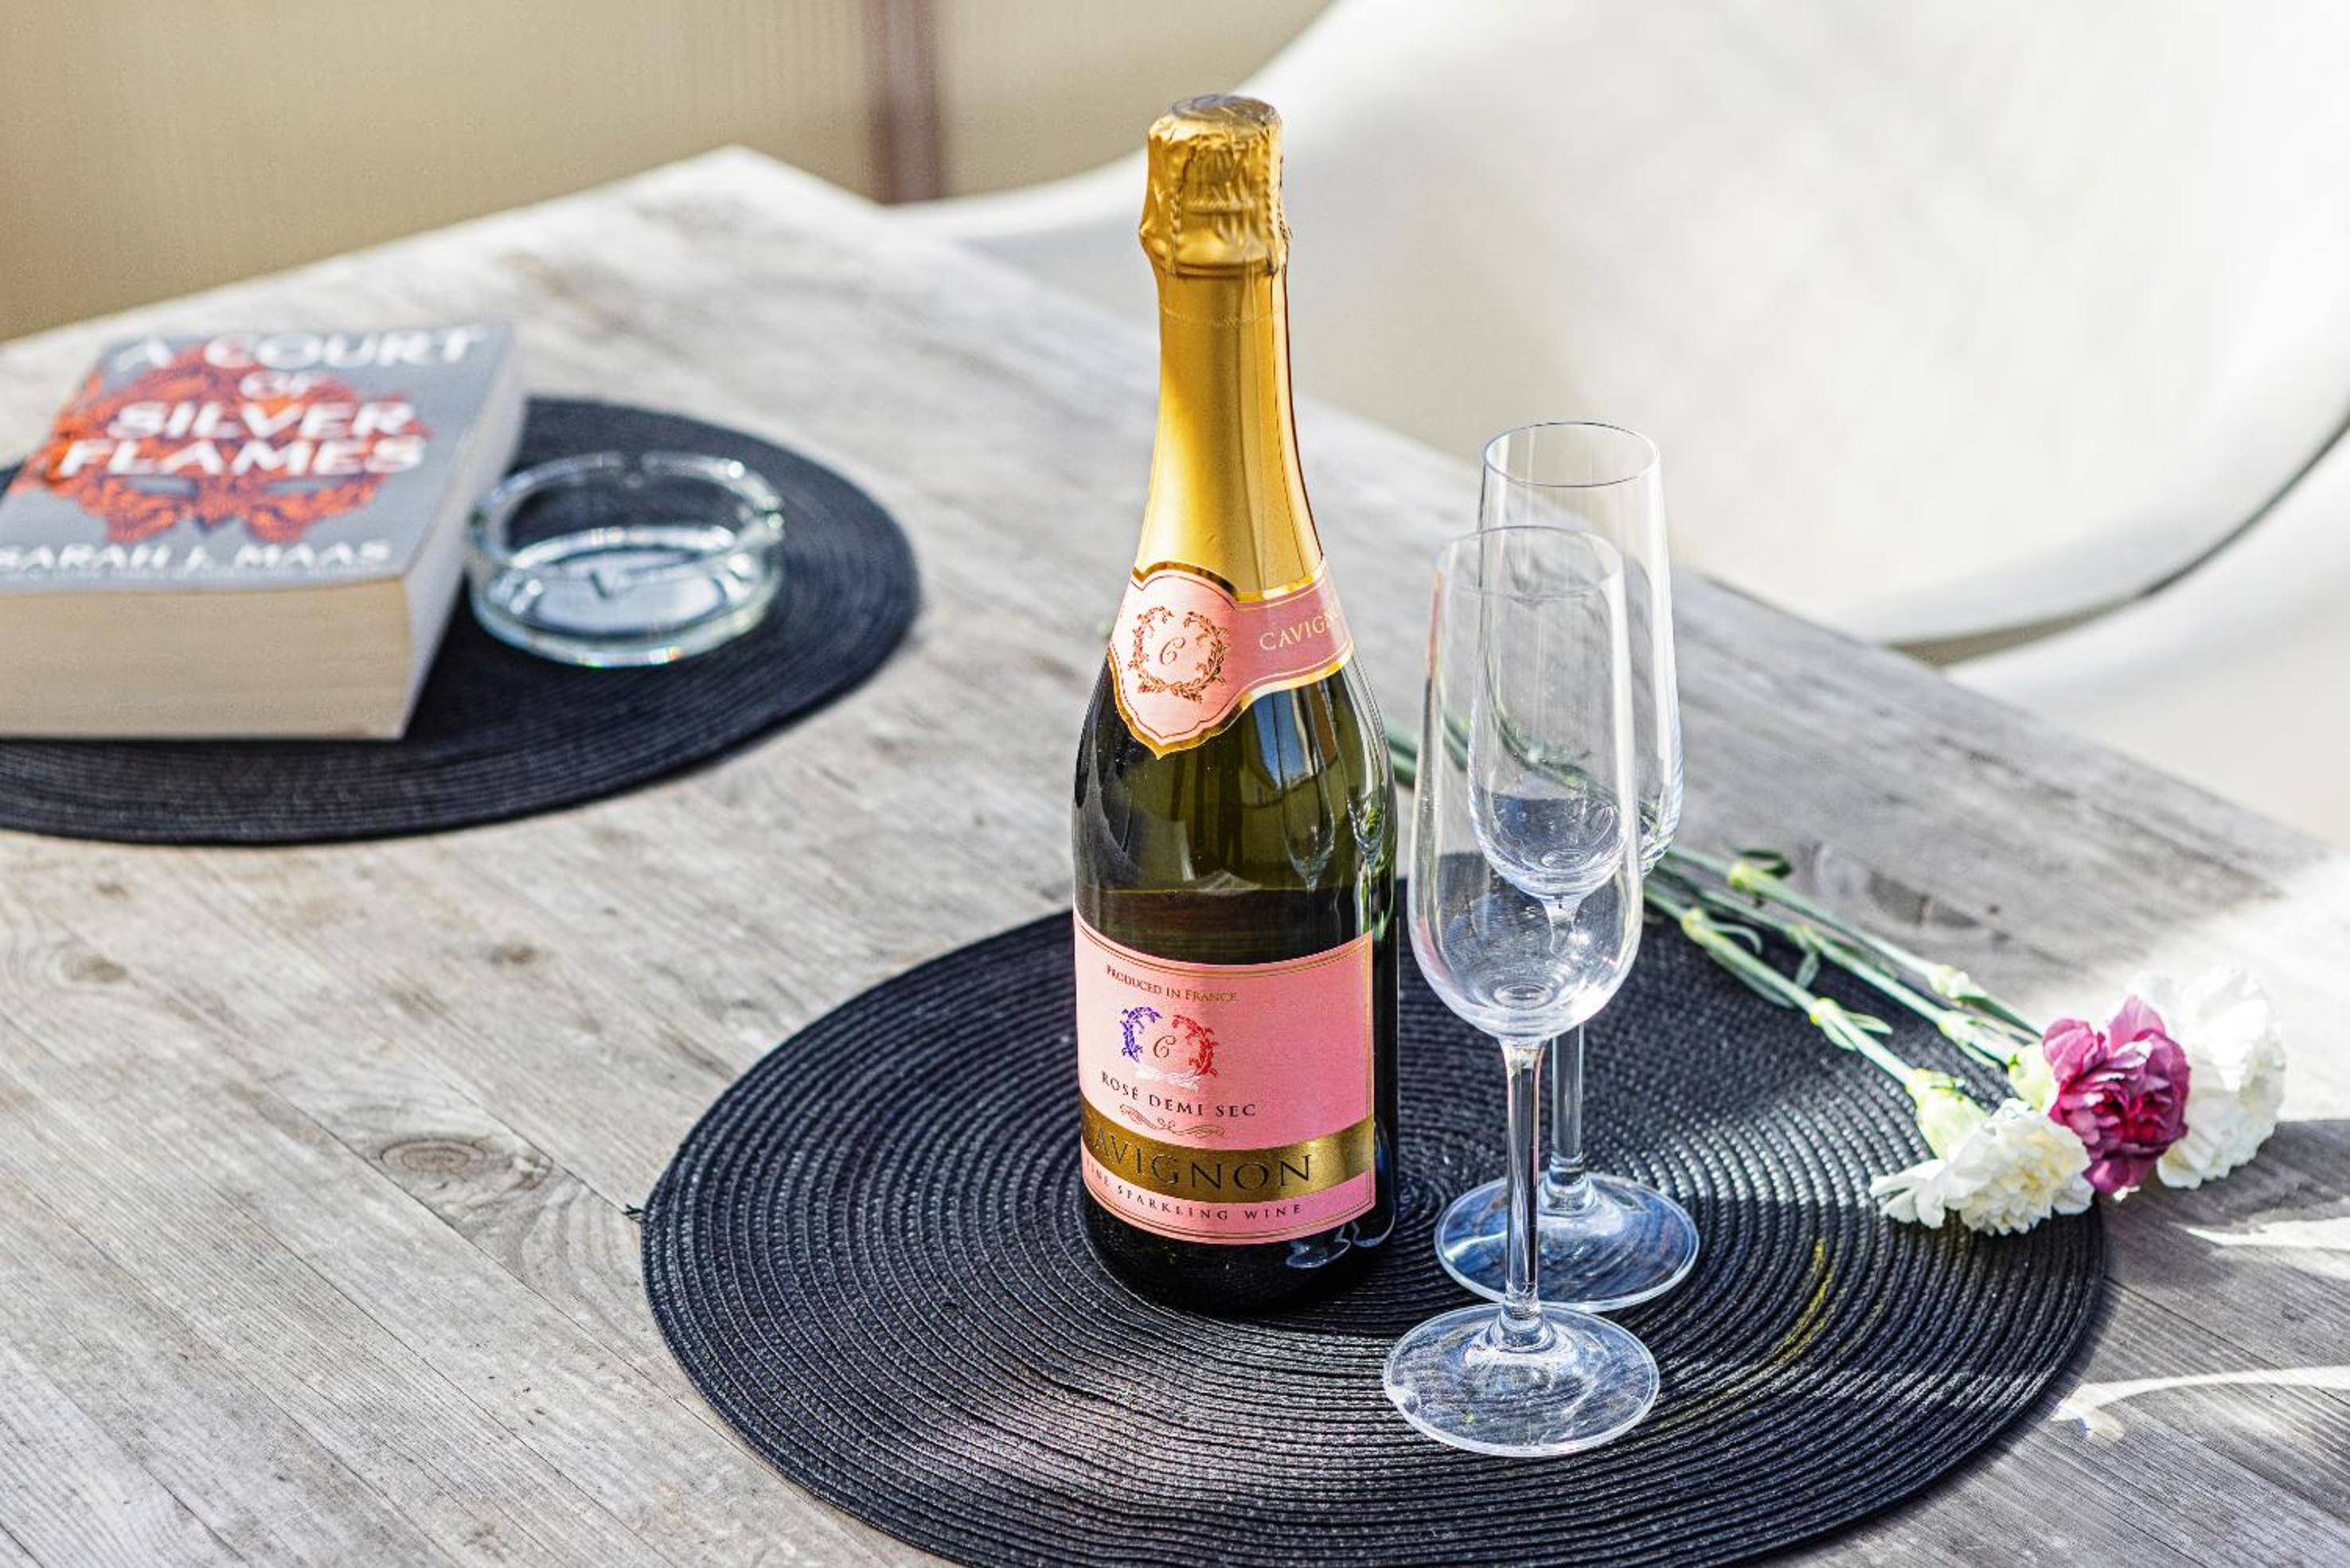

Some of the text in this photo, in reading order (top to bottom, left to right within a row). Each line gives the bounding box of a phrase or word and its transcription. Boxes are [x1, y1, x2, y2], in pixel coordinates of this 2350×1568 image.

[116, 325, 486, 370] A COURT
[239, 371, 317, 399] OF
[107, 401, 419, 439] SILVER
[58, 435, 426, 476] FLAMES
[0, 543, 171, 570] SARAH
[233, 540, 389, 569] MAAS
[1106, 965, 1237, 1001] PRODUCED IN FRANCE
[1102, 1071, 1255, 1117] ROSÉ DEMI SEC
[1118, 1185, 1228, 1220] SPARKLING
[1244, 1204, 1300, 1219] WINE
